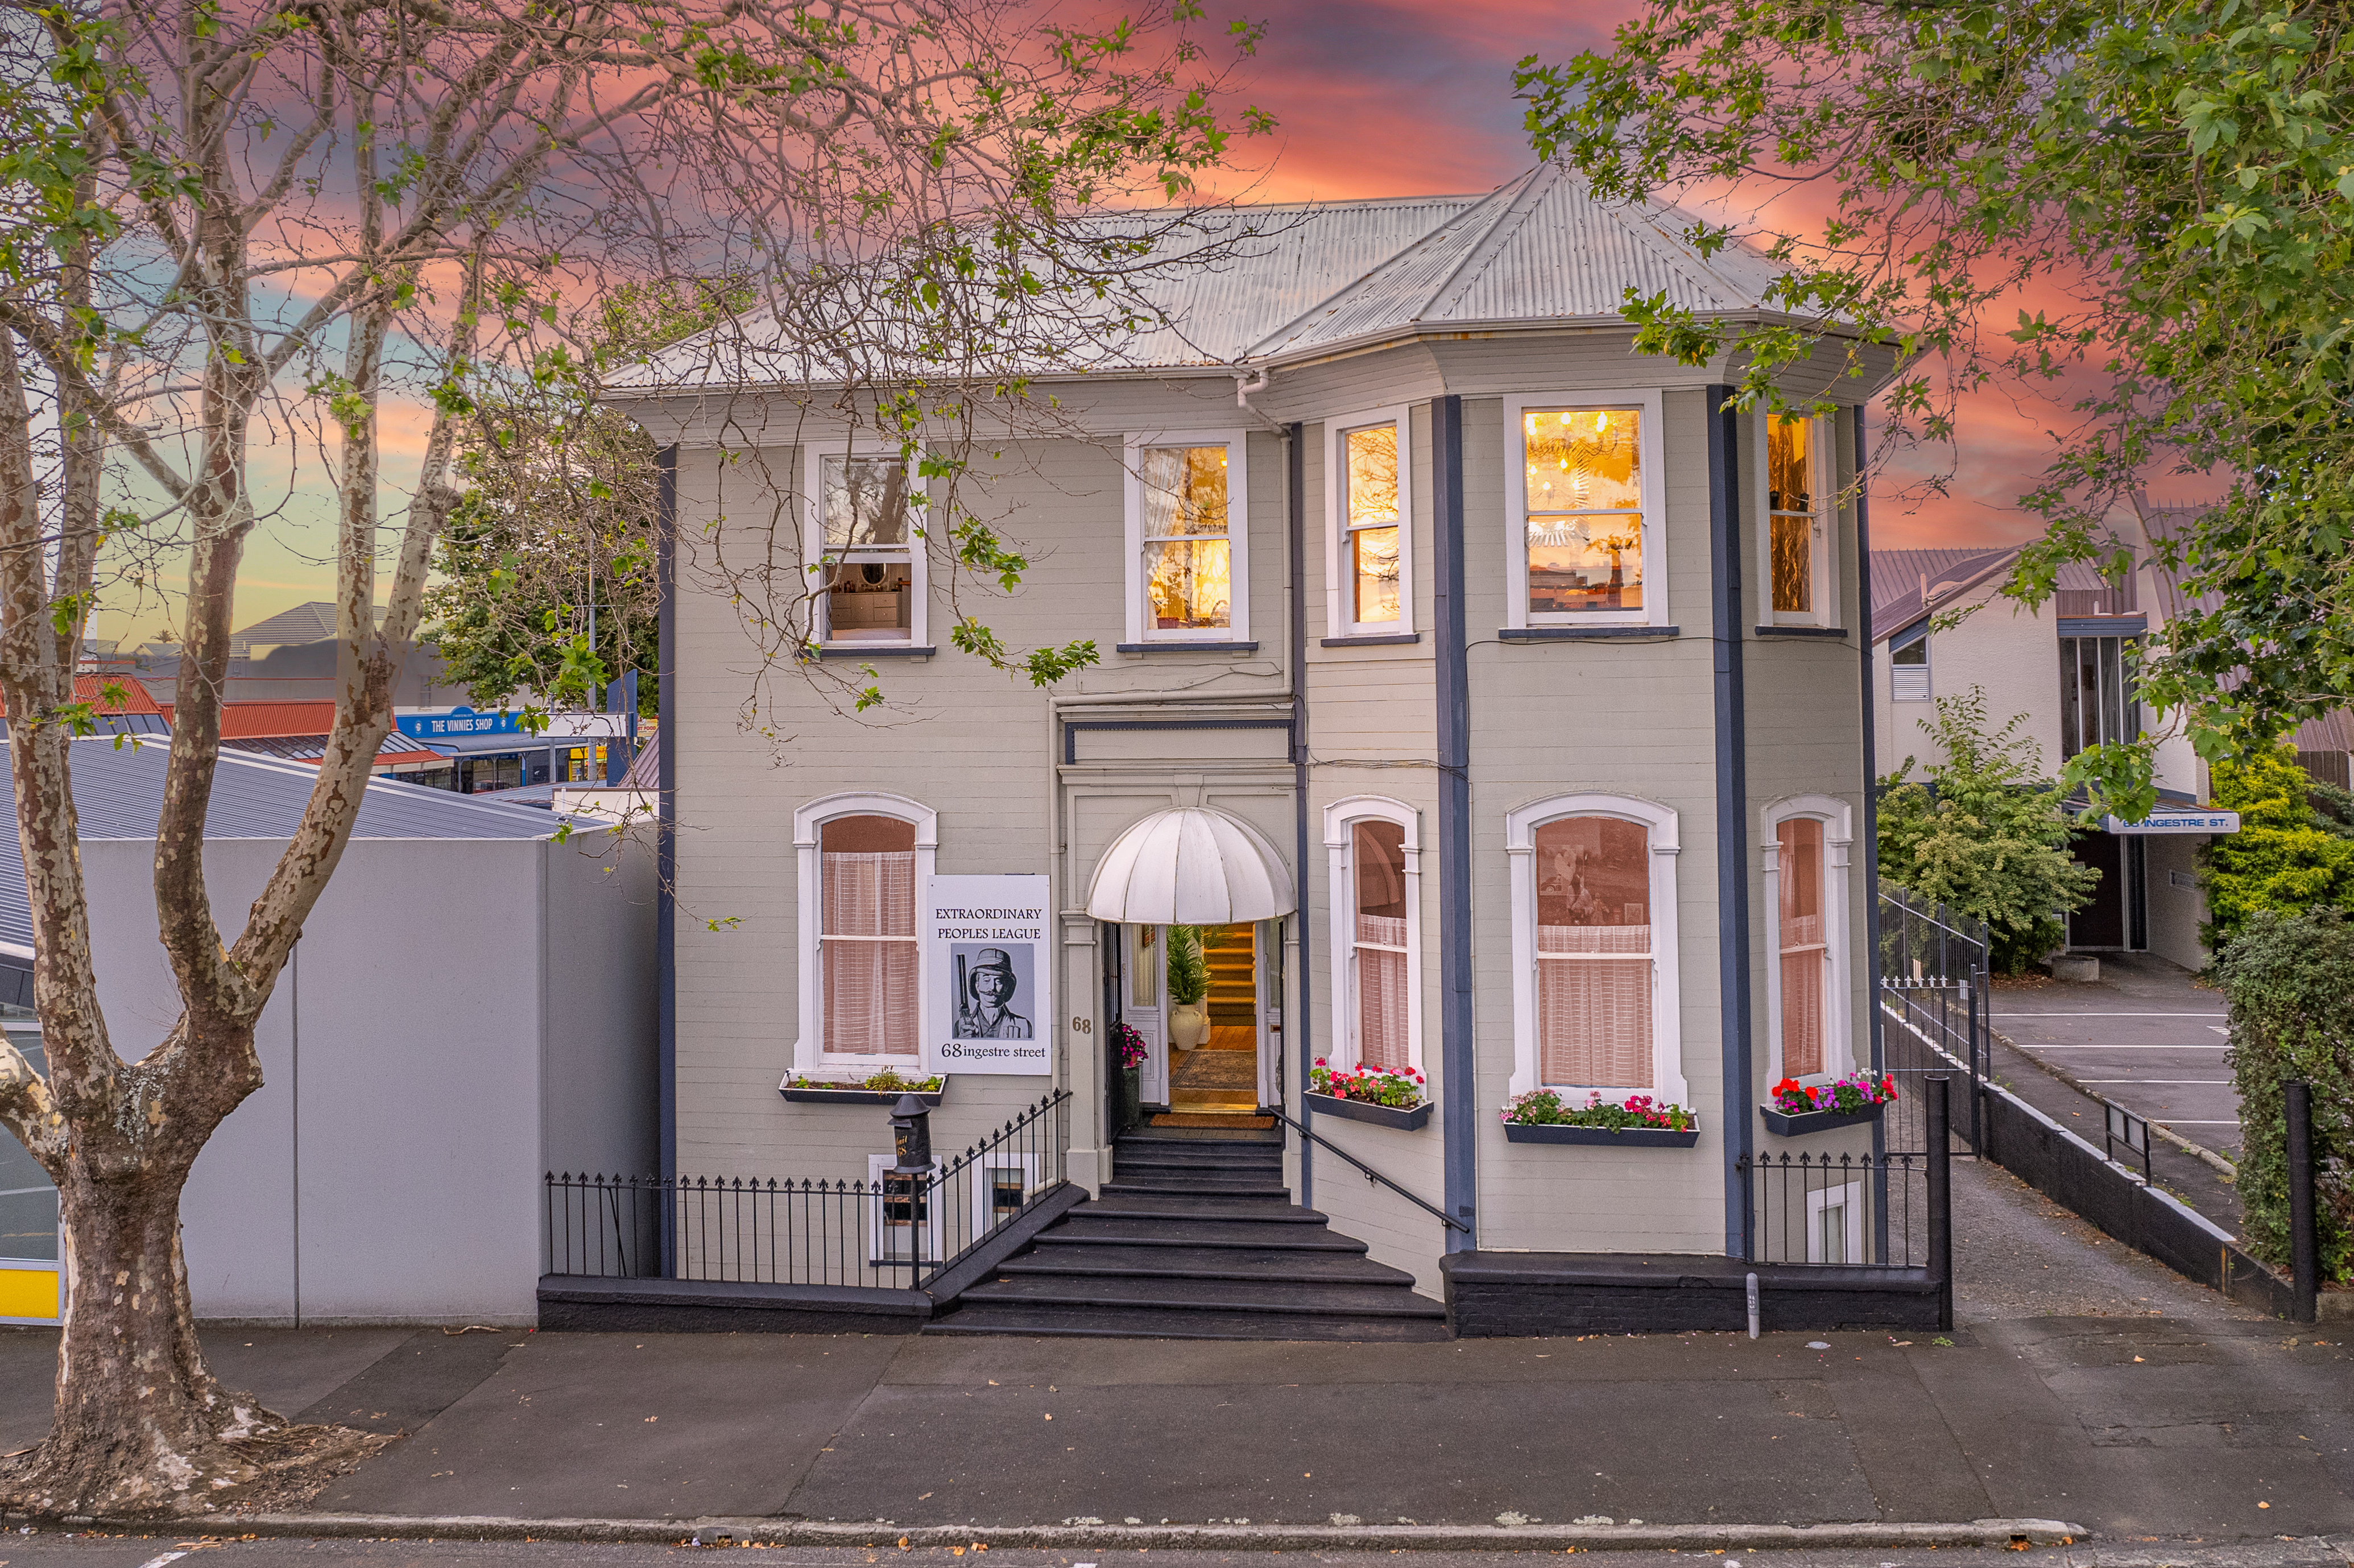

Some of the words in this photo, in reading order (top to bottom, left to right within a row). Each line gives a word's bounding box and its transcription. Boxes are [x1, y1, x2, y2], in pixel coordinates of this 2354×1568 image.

[431, 721, 445, 733] THE
[447, 719, 473, 732] VINNIES
[475, 718, 493, 730] SHOP
[936, 908, 1042, 919] EXTRAORDINARY
[938, 928, 988, 939] PEOPLES
[992, 928, 1041, 939] LEAGUE
[1072, 1016, 1091, 1035] 68
[941, 1043, 962, 1057] 68
[963, 1045, 1010, 1060] ingestre
[1013, 1048, 1045, 1057] street
[897, 1145, 907, 1157] 68
